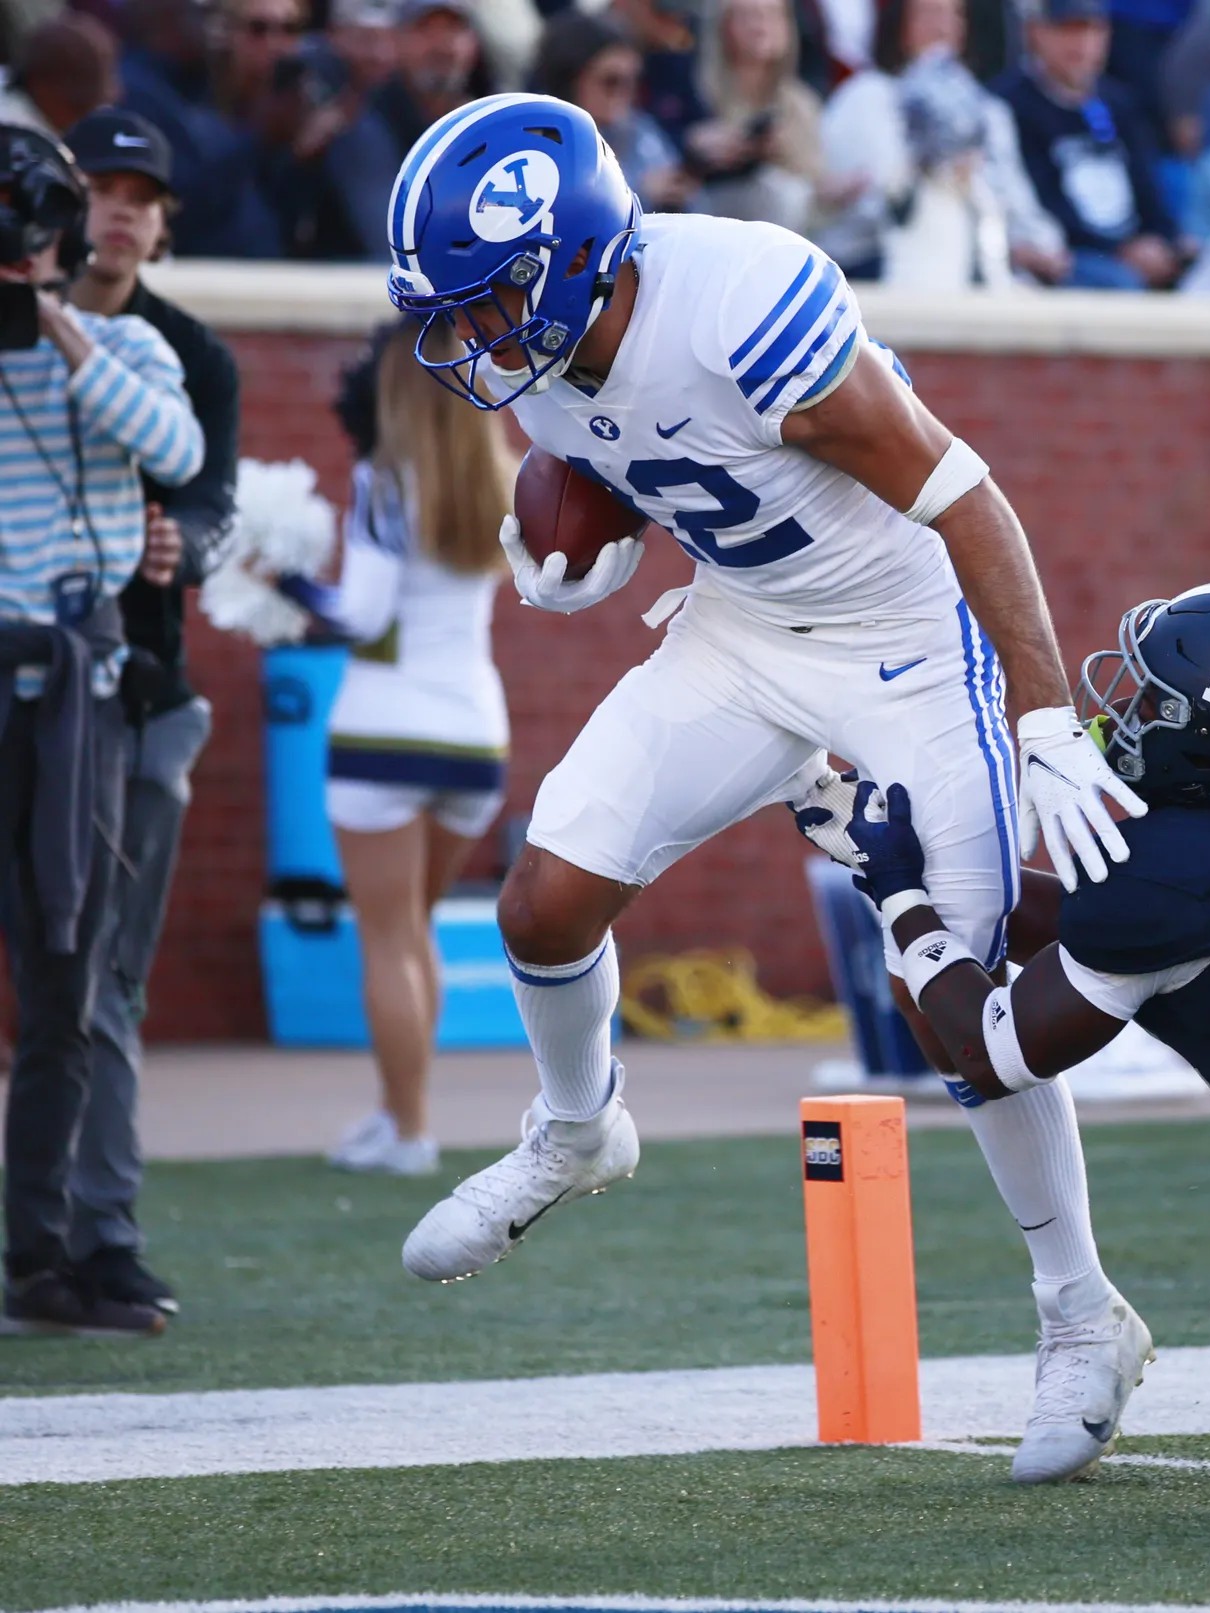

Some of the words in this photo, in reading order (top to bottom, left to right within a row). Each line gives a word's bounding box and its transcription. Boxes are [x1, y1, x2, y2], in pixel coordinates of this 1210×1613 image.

[476, 158, 545, 225] Y
[918, 940, 947, 958] adidas
[804, 1137, 841, 1165] SBC
